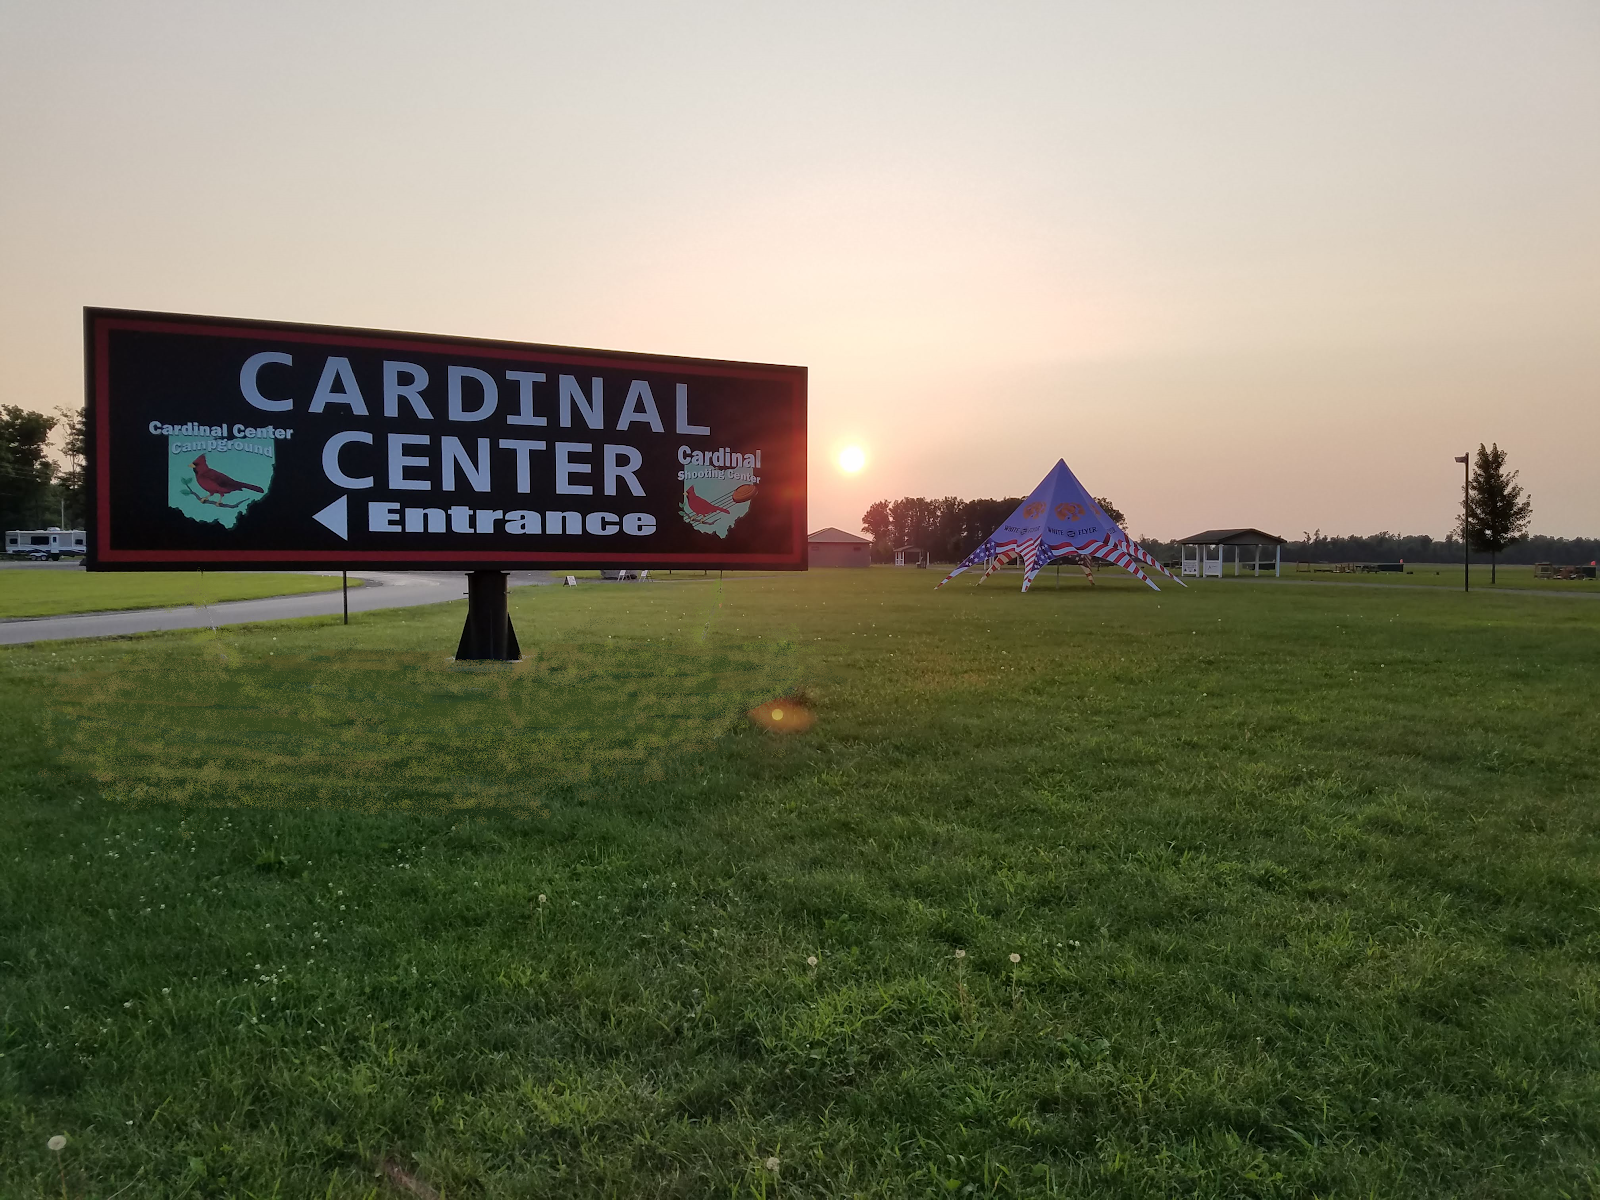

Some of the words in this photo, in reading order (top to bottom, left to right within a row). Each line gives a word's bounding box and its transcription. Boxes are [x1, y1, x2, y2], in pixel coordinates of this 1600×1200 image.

[239, 351, 711, 436] CARDINAL
[149, 420, 228, 437] Cardinal
[232, 423, 294, 439] Center
[171, 438, 274, 458] Campground
[677, 445, 762, 469] Cardinal
[321, 430, 647, 497] CENTER
[677, 468, 726, 481] Shooting
[727, 468, 761, 484] Center
[368, 501, 657, 536] Entrance
[1047, 525, 1064, 536] WHITE
[1077, 526, 1098, 536] FLYER
